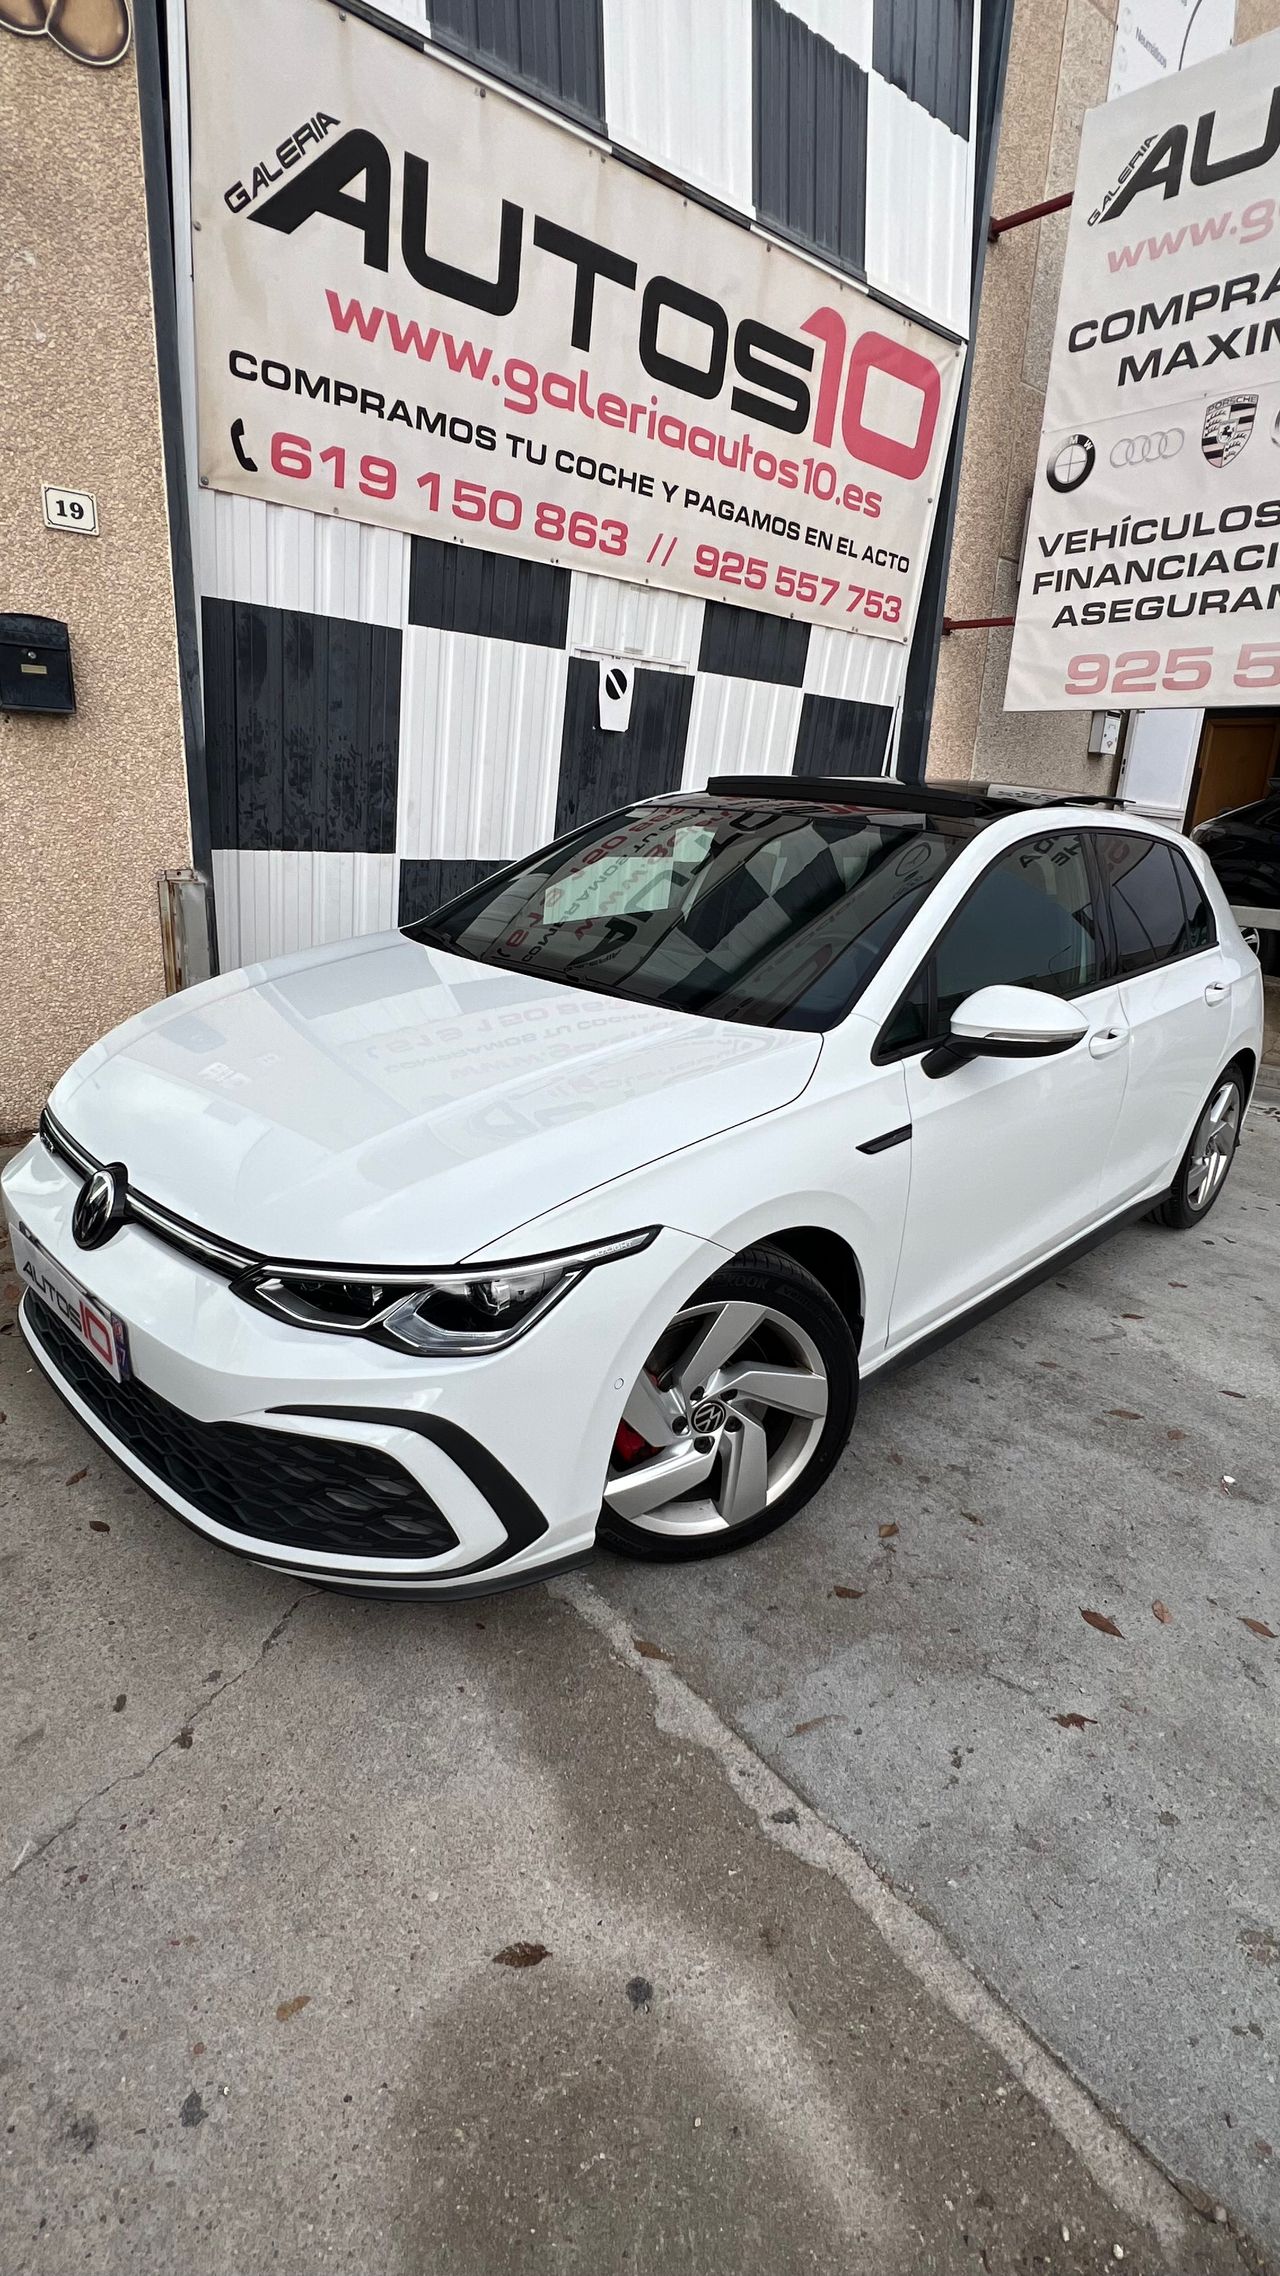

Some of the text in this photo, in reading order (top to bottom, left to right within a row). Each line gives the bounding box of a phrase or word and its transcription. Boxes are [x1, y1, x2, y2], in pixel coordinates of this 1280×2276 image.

[224, 112, 341, 214] GALERIA
[1087, 134, 1159, 227] GALERIA
[325, 289, 882, 519] www.galeriaautos10.es
[1206, 394, 1259, 414] PORSCHE
[229, 350, 910, 574] COMPRAMOS TU COCHE Y PAGAMOS EN EL ACTO
[55, 499, 85, 520] 19
[270, 431, 397, 500] 619
[416, 472, 523, 531] 150
[534, 502, 629, 557] 863
[693, 544, 769, 590] 925
[774, 565, 840, 606] 557
[846, 584, 903, 623] 753
[1038, 500, 1280, 558] VEHÍCULOS
[1033, 542, 1279, 595] FINANCIACI
[1064, 646, 1214, 695] 925
